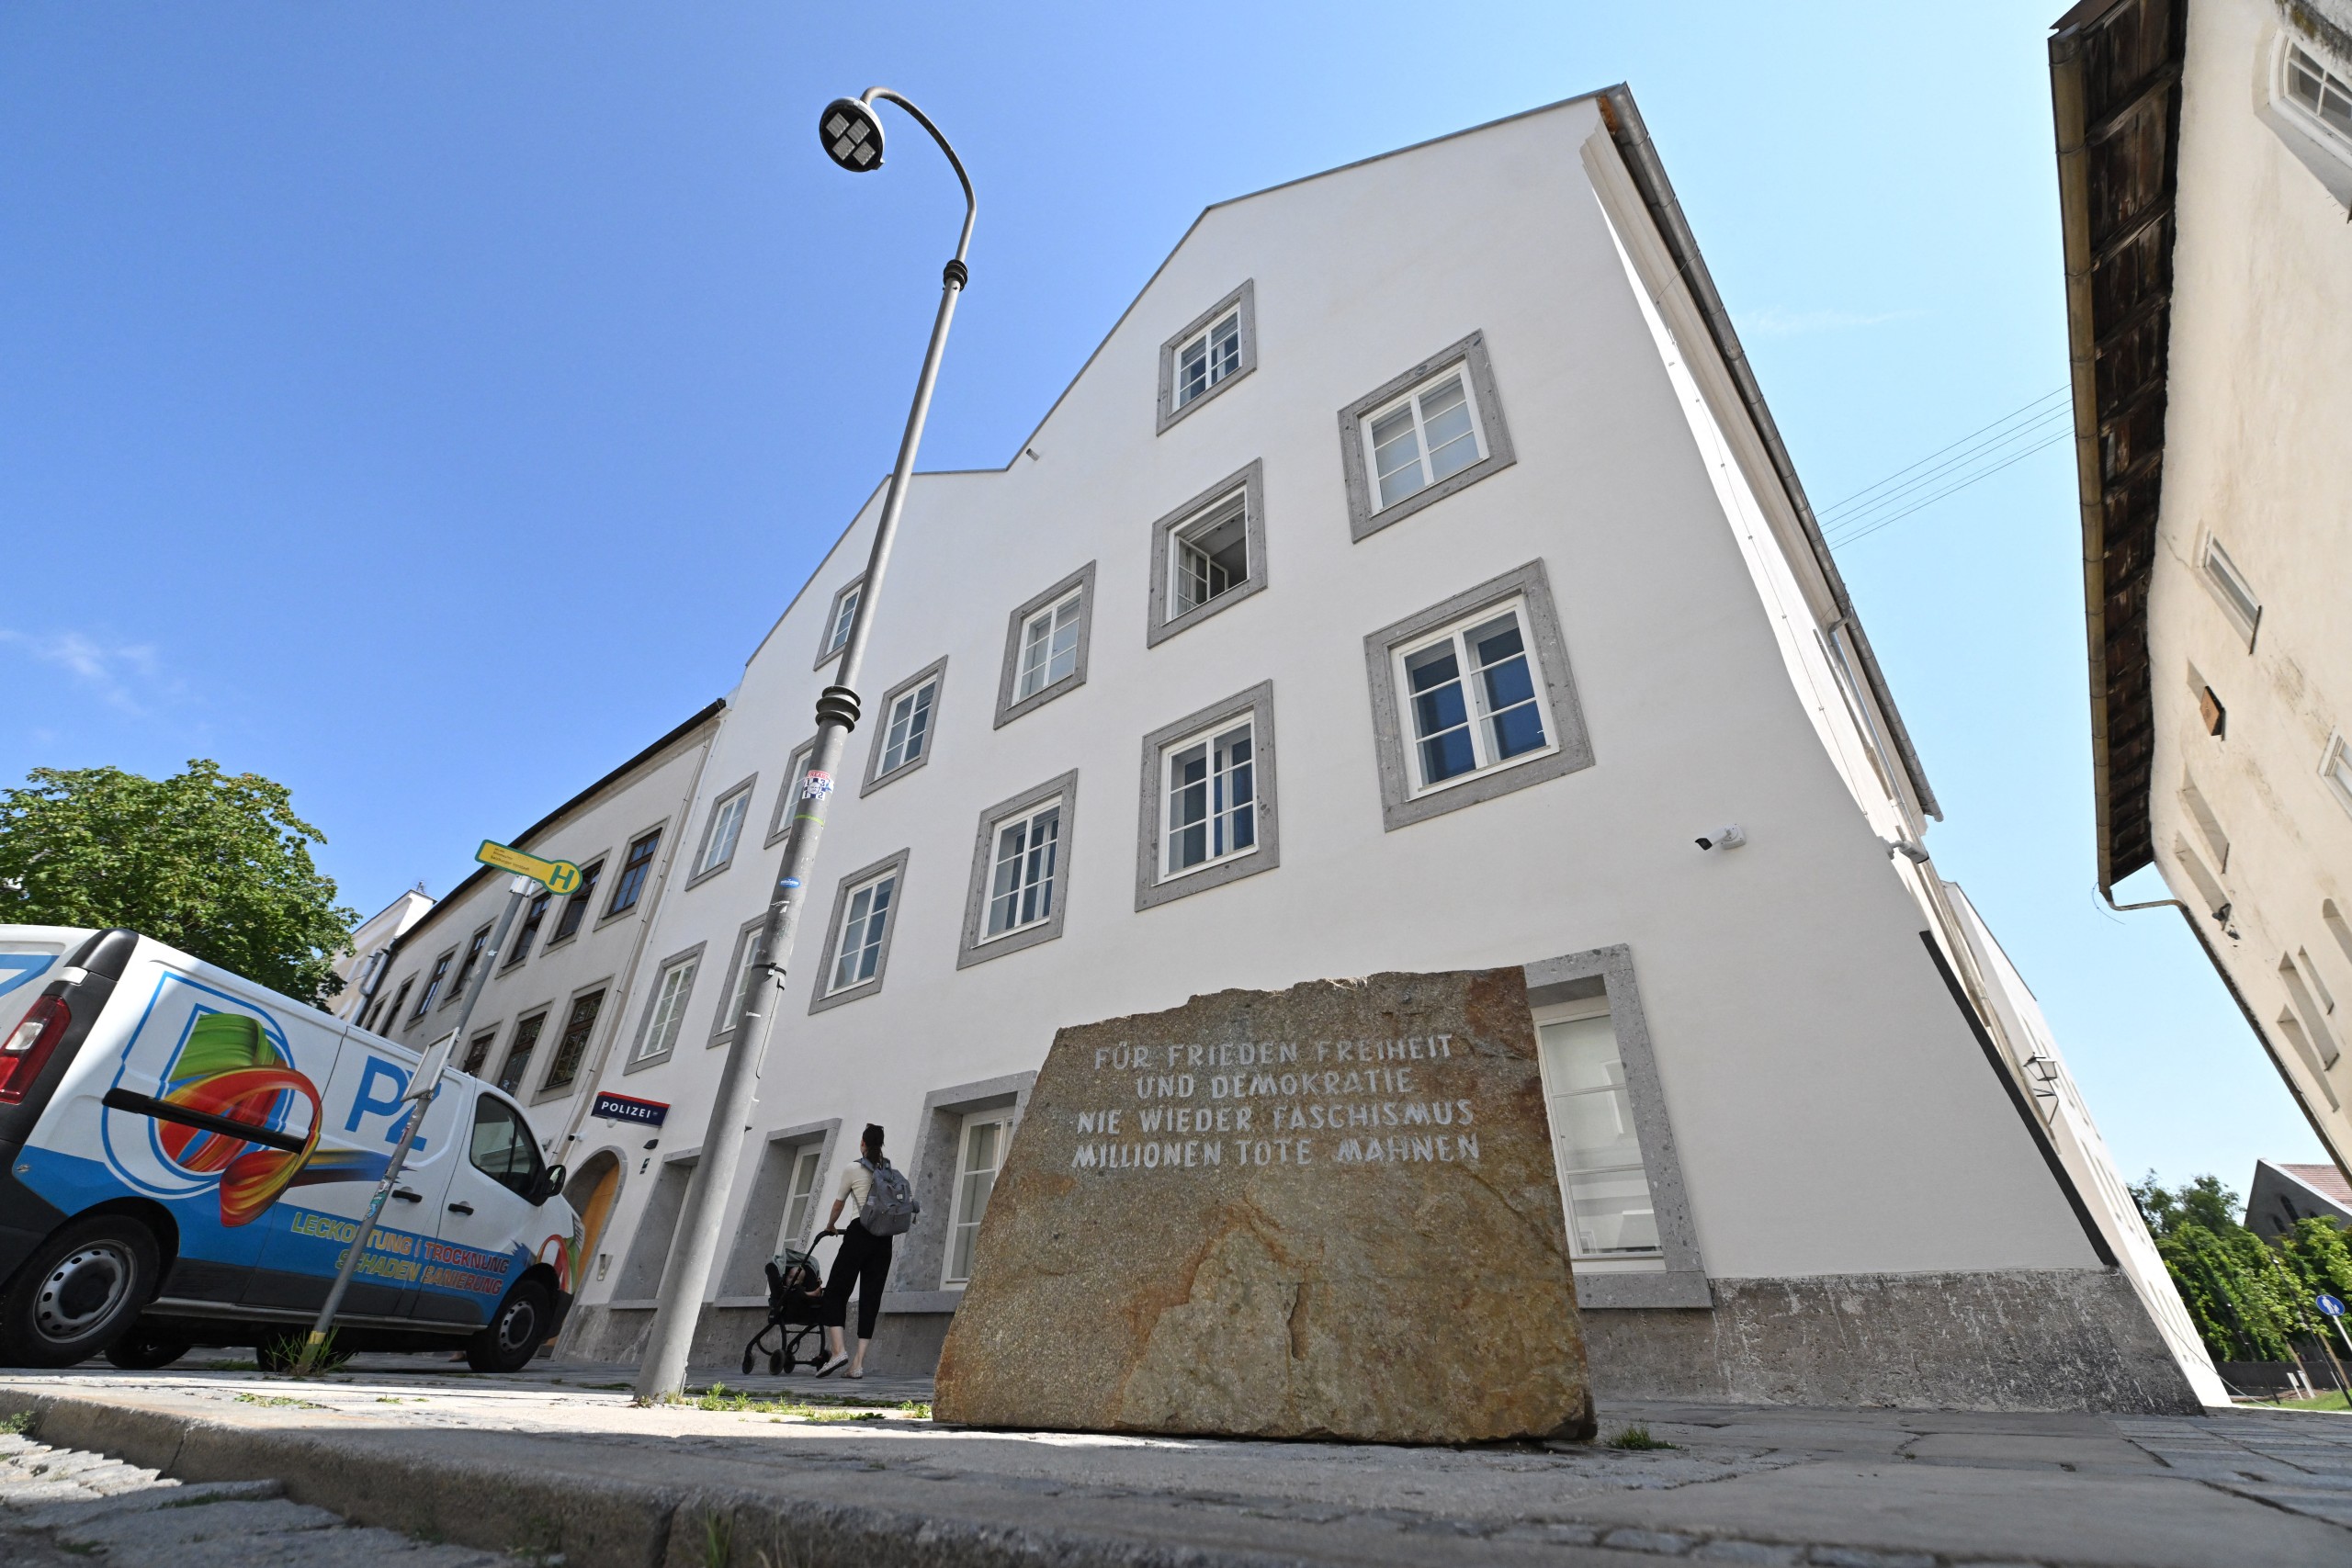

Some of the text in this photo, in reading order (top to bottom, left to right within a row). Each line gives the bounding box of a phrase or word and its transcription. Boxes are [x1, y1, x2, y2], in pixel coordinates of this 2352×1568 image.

[548, 864, 575, 890] H
[1093, 1033, 1453, 1070] FÜR FRIEDEN FREIHEIT
[1136, 1066, 1413, 1100] UND DEMOKRATIE
[601, 1101, 651, 1118] POLIZEI
[1077, 1099, 1474, 1134] NIE WIEDER FASCHISMUS
[1070, 1133, 1480, 1168] MILLIONEN TOTE MAHNEN
[290, 1212, 413, 1256] LECKOTUNG
[424, 1241, 511, 1275] TROCKNUNG
[421, 1265, 503, 1296] SANIERUNG
